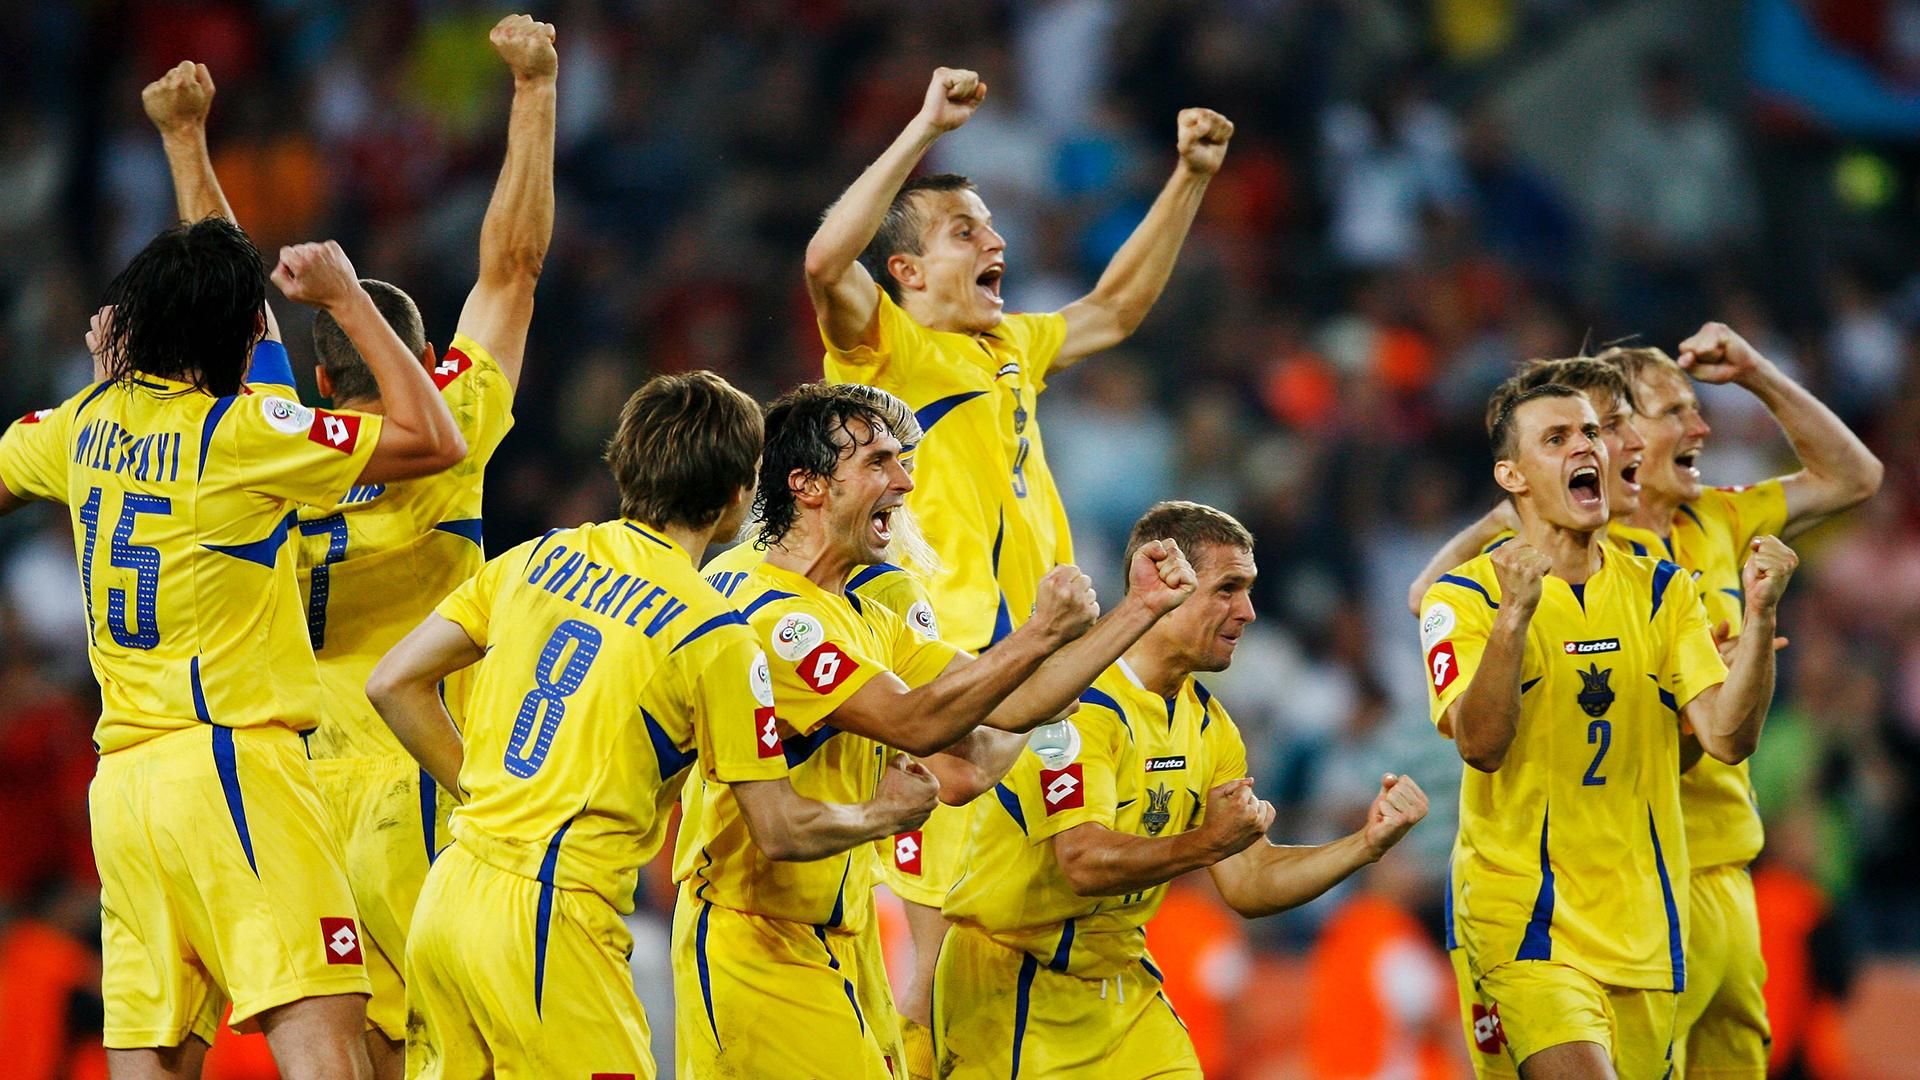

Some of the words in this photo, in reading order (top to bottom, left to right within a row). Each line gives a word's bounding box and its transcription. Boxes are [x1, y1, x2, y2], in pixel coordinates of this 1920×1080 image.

[1012, 437, 1029, 498] 9
[80, 486, 172, 651] 15
[299, 512, 348, 650] 7
[527, 545, 688, 639] SHELAYEV
[1577, 641, 1618, 652] lotto
[504, 619, 602, 780] 8
[1153, 759, 1185, 769] lotto
[1582, 720, 1612, 786] 2
